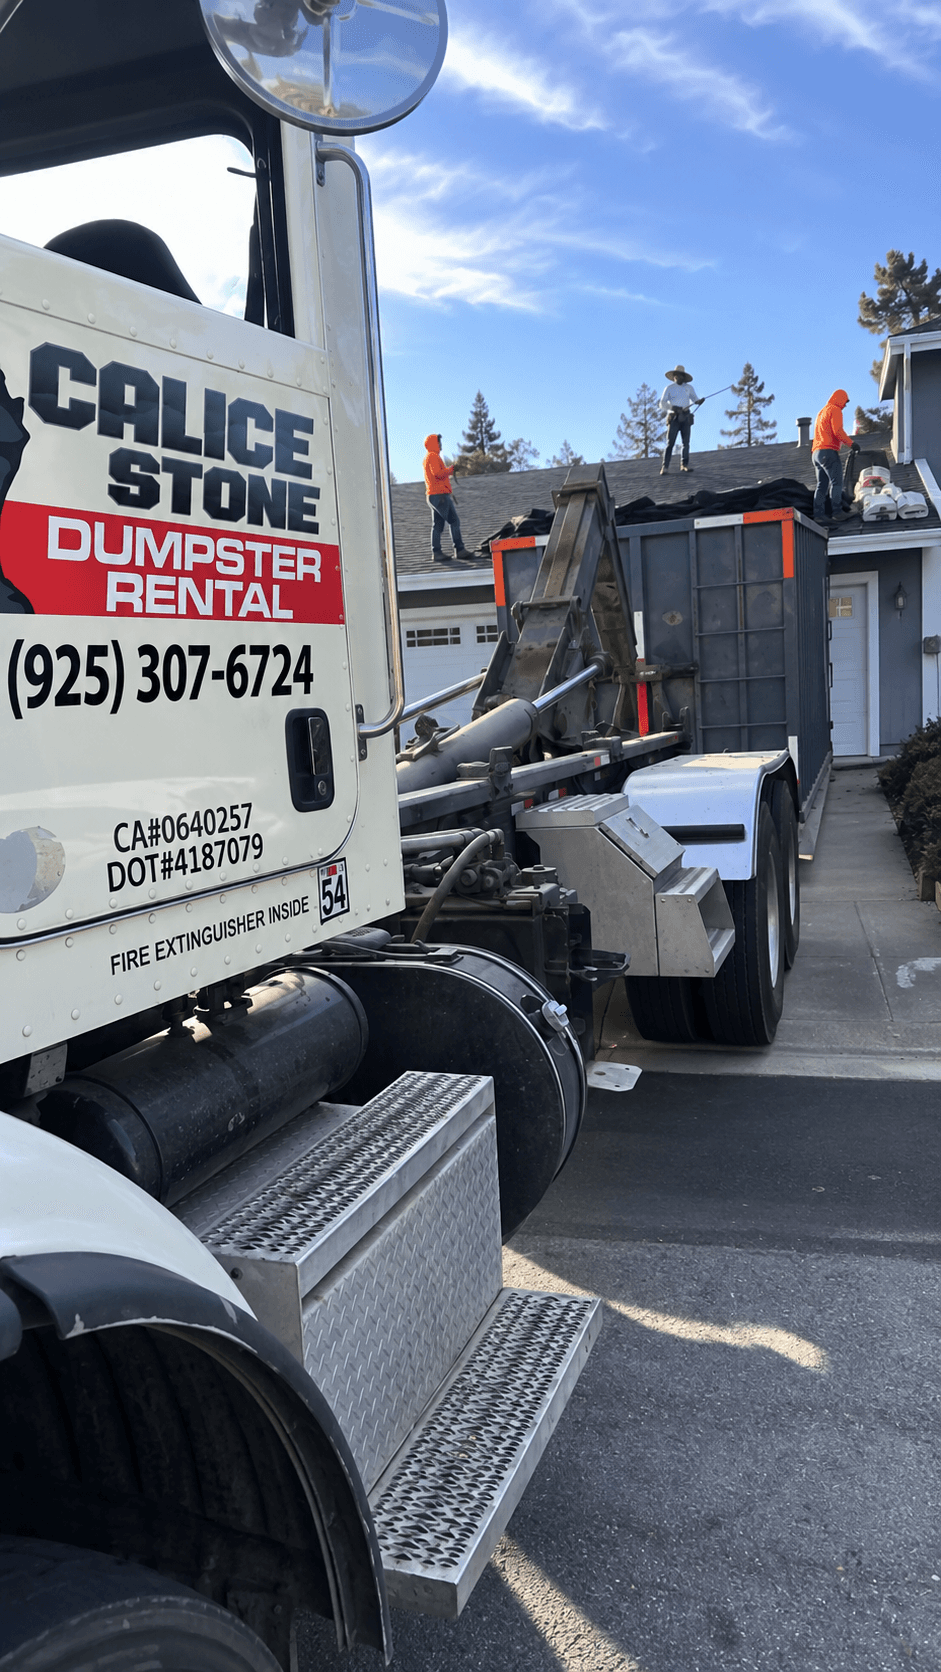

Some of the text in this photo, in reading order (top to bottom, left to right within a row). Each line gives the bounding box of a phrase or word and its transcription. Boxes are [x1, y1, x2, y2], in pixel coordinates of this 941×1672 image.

[28, 342, 314, 479] CALICE
[107, 447, 320, 535] STONE
[47, 515, 321, 583] DUMPSTER
[106, 571, 293, 619] RENTAL
[8, 638, 314, 719] (925) 307-6724
[113, 802, 252, 853] CA#0640257
[107, 833, 264, 892] DOT#4187079
[322, 874, 346, 915] 54
[110, 896, 310, 975] FIRE EXTINGUISHER INSIDE
